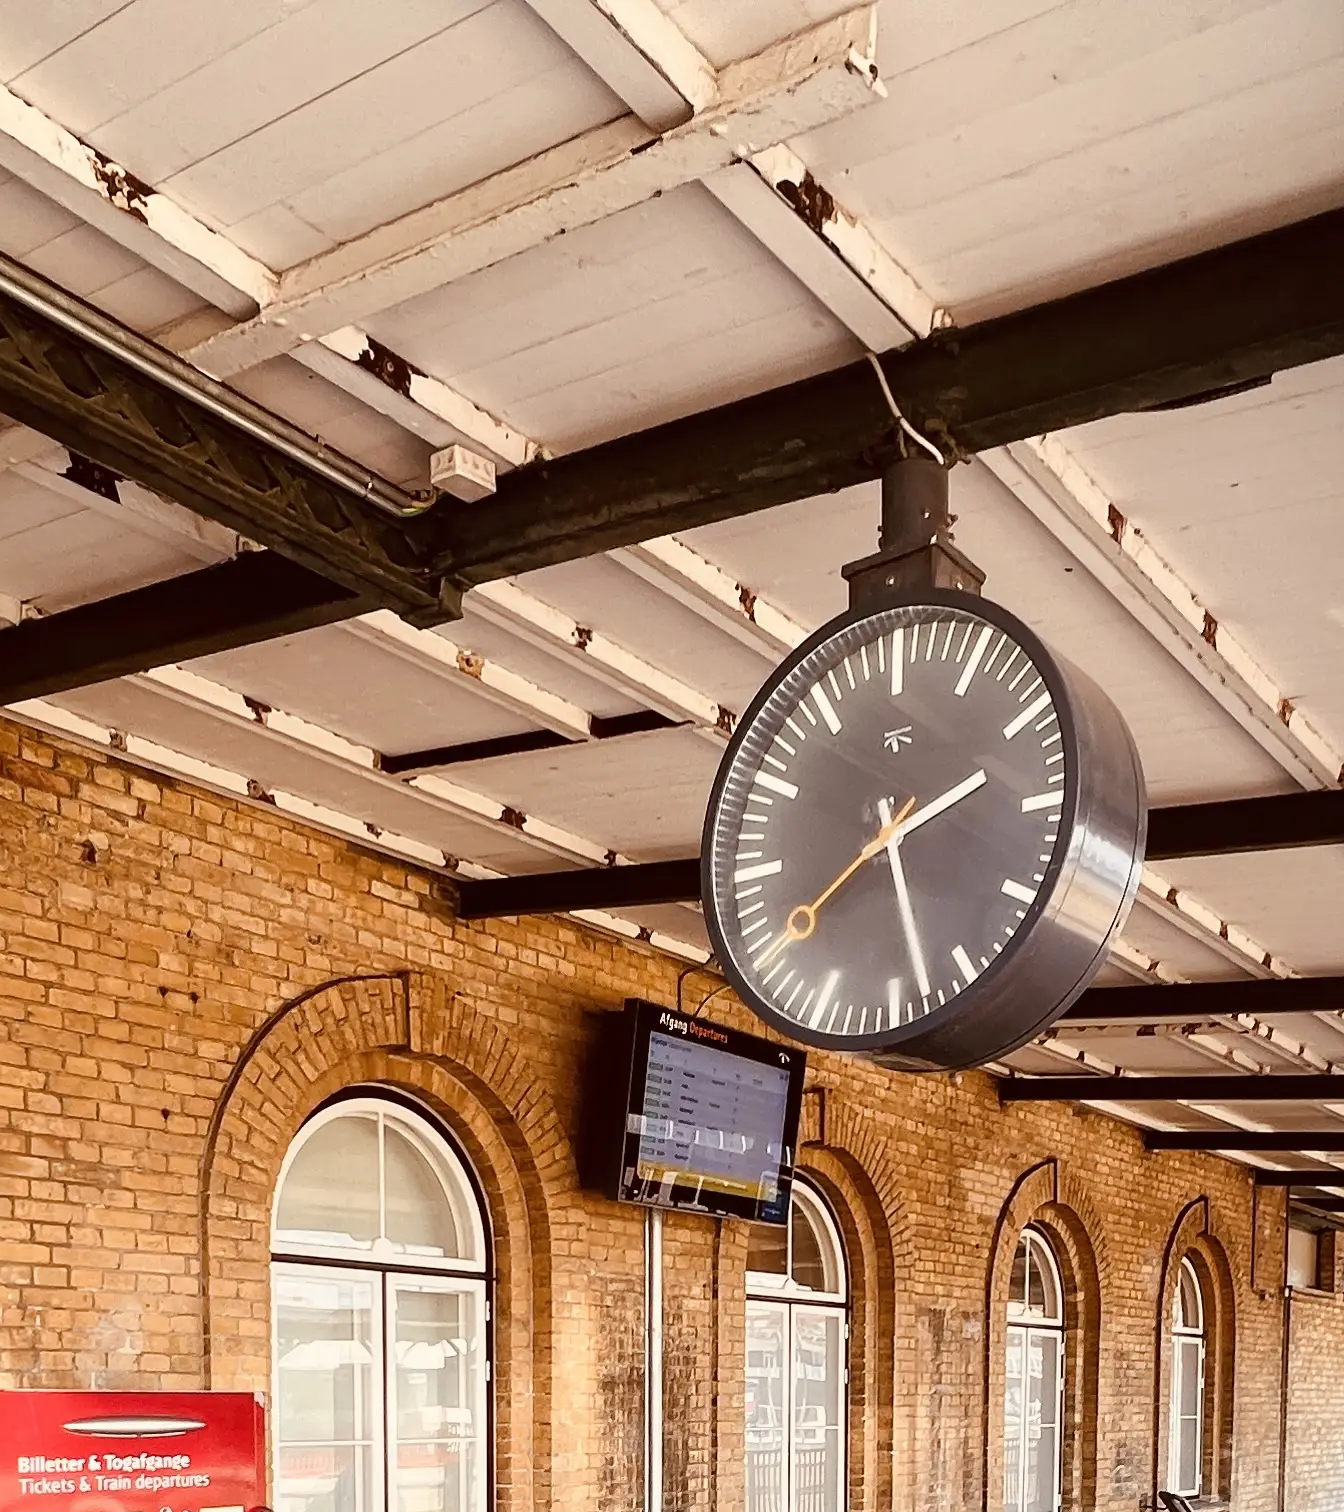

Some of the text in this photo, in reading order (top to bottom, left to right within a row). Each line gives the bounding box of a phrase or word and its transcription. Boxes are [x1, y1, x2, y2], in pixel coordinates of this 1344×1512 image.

[659, 1012, 729, 1044] Afgang Departures
[17, 1453, 191, 1473] Billetter & Togafgange
[18, 1473, 211, 1495] Tickets & Train departures
